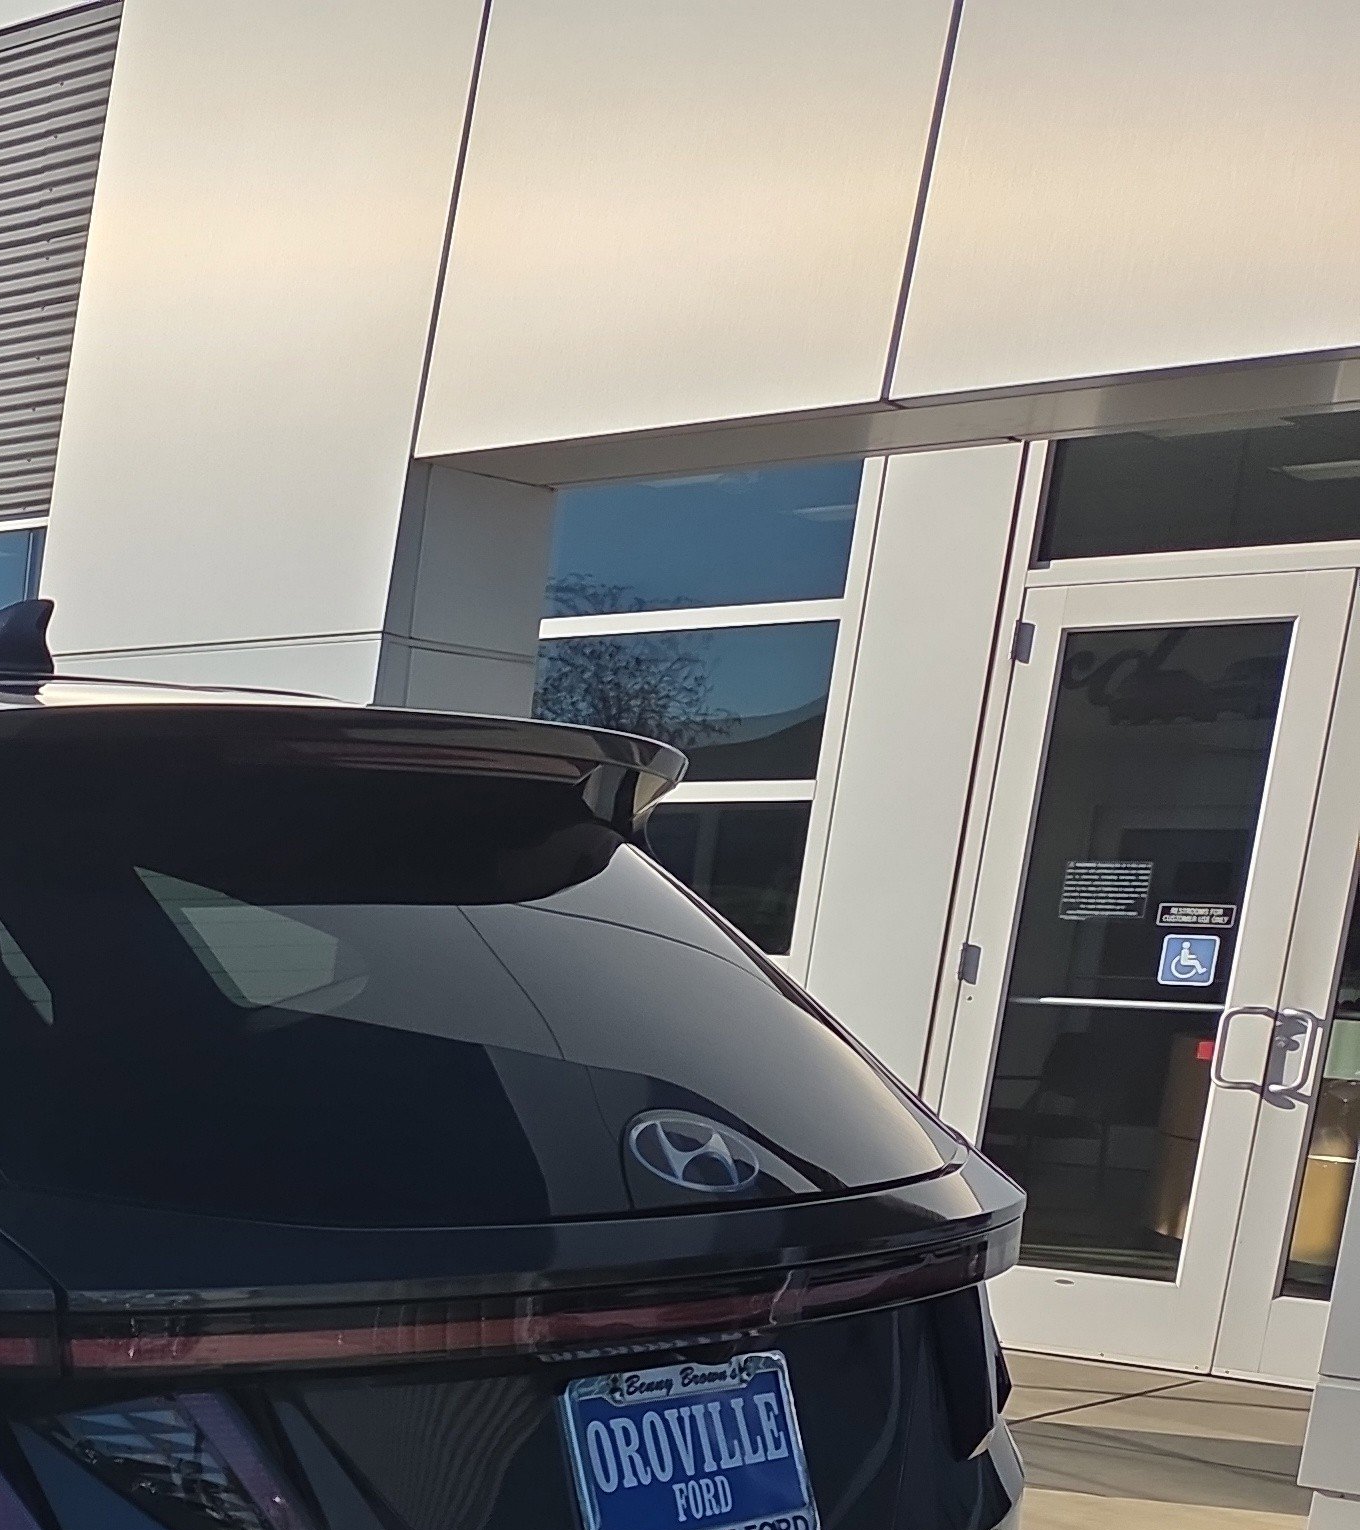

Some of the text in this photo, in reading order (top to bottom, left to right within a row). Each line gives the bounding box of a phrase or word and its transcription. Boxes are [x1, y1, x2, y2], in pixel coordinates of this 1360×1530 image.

[624, 1374, 674, 1396] Benny
[586, 1392, 789, 1493] OROVILLE
[672, 1475, 733, 1521] FORD
